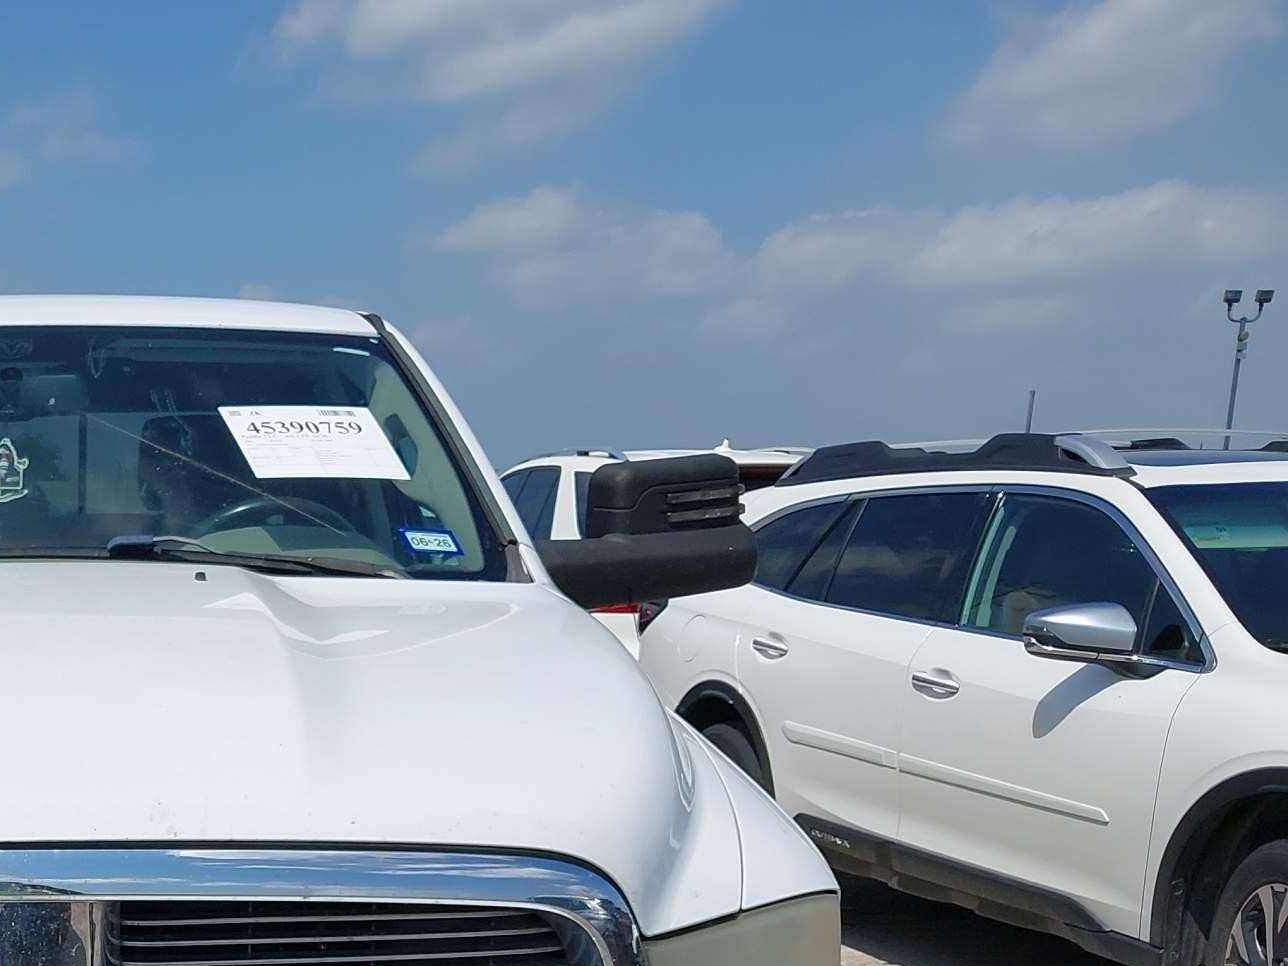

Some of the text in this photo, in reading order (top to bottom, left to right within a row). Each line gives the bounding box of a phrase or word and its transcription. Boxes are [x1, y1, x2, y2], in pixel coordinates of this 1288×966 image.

[247, 421, 363, 435] 45390759
[410, 536, 452, 548] 06 26
